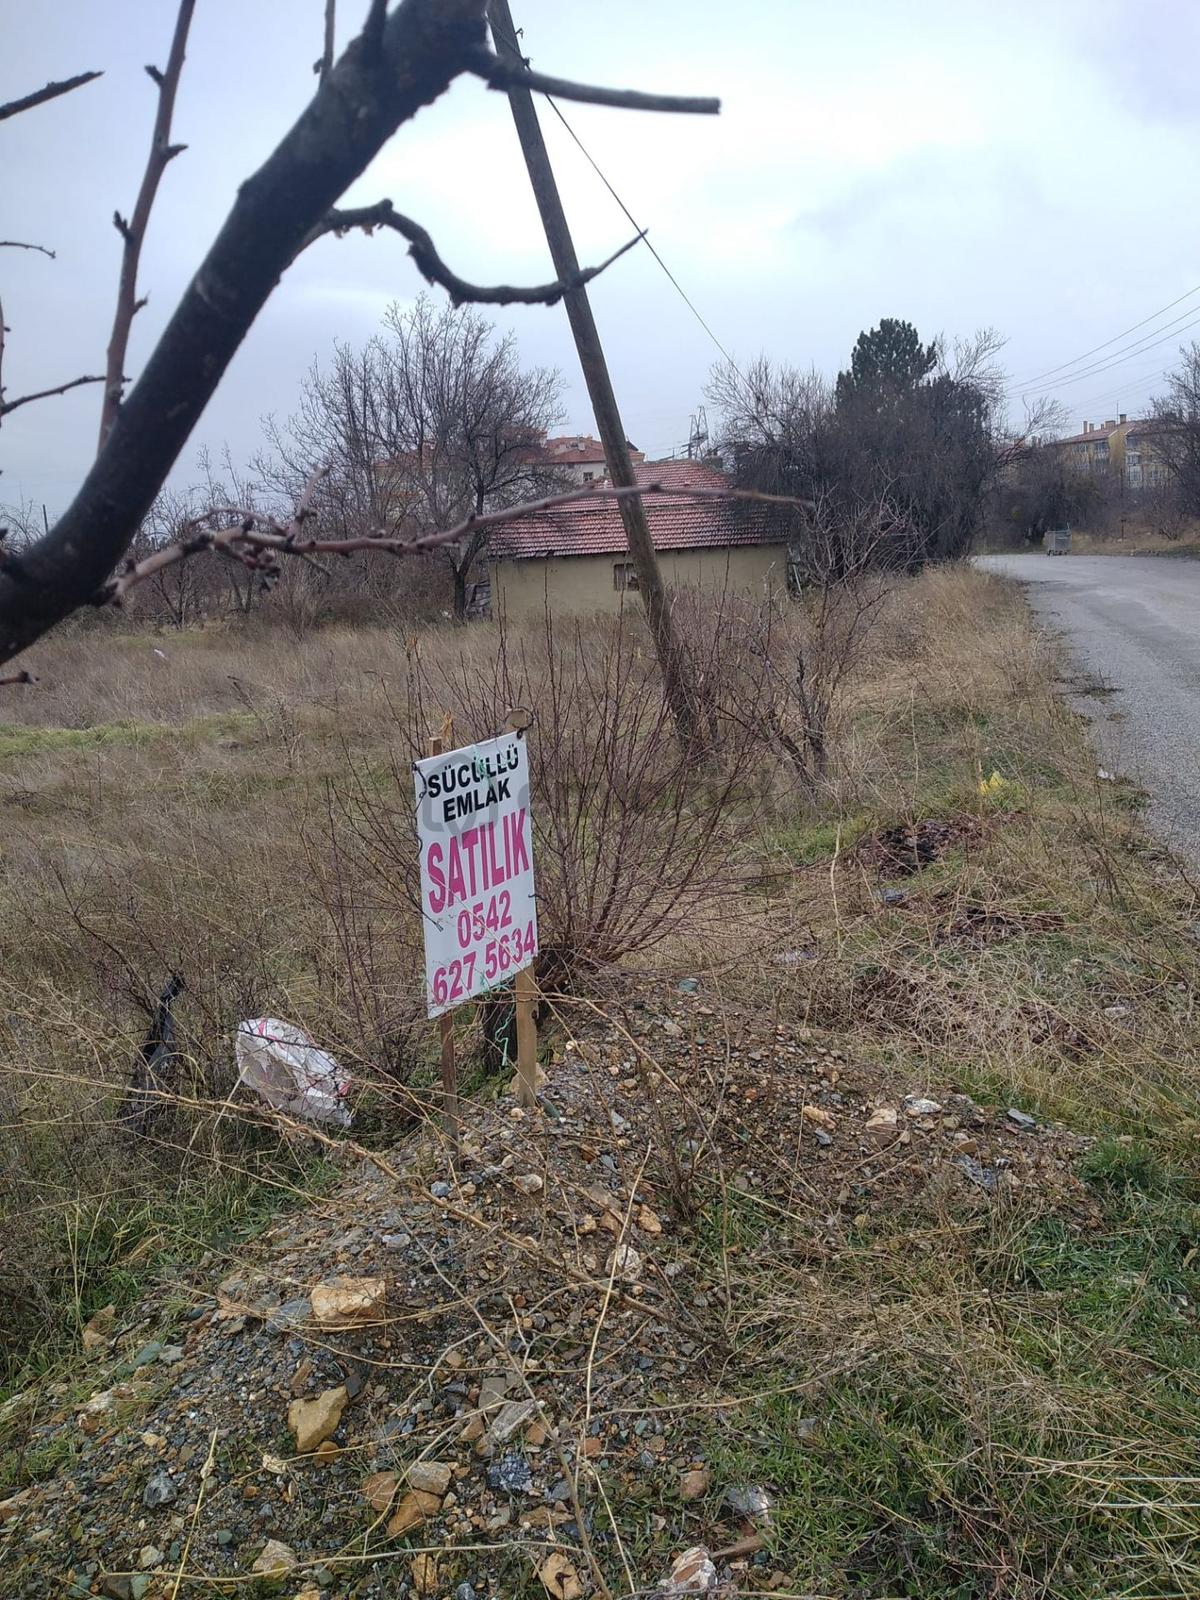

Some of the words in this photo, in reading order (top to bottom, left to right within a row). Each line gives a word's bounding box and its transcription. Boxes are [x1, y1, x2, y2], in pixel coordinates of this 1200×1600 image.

[443, 777, 511, 823] EMLAK
[427, 807, 529, 914] SATILIK
[457, 889, 512, 949] 0542
[433, 951, 477, 1007] 627
[485, 920, 535, 979] 5634
